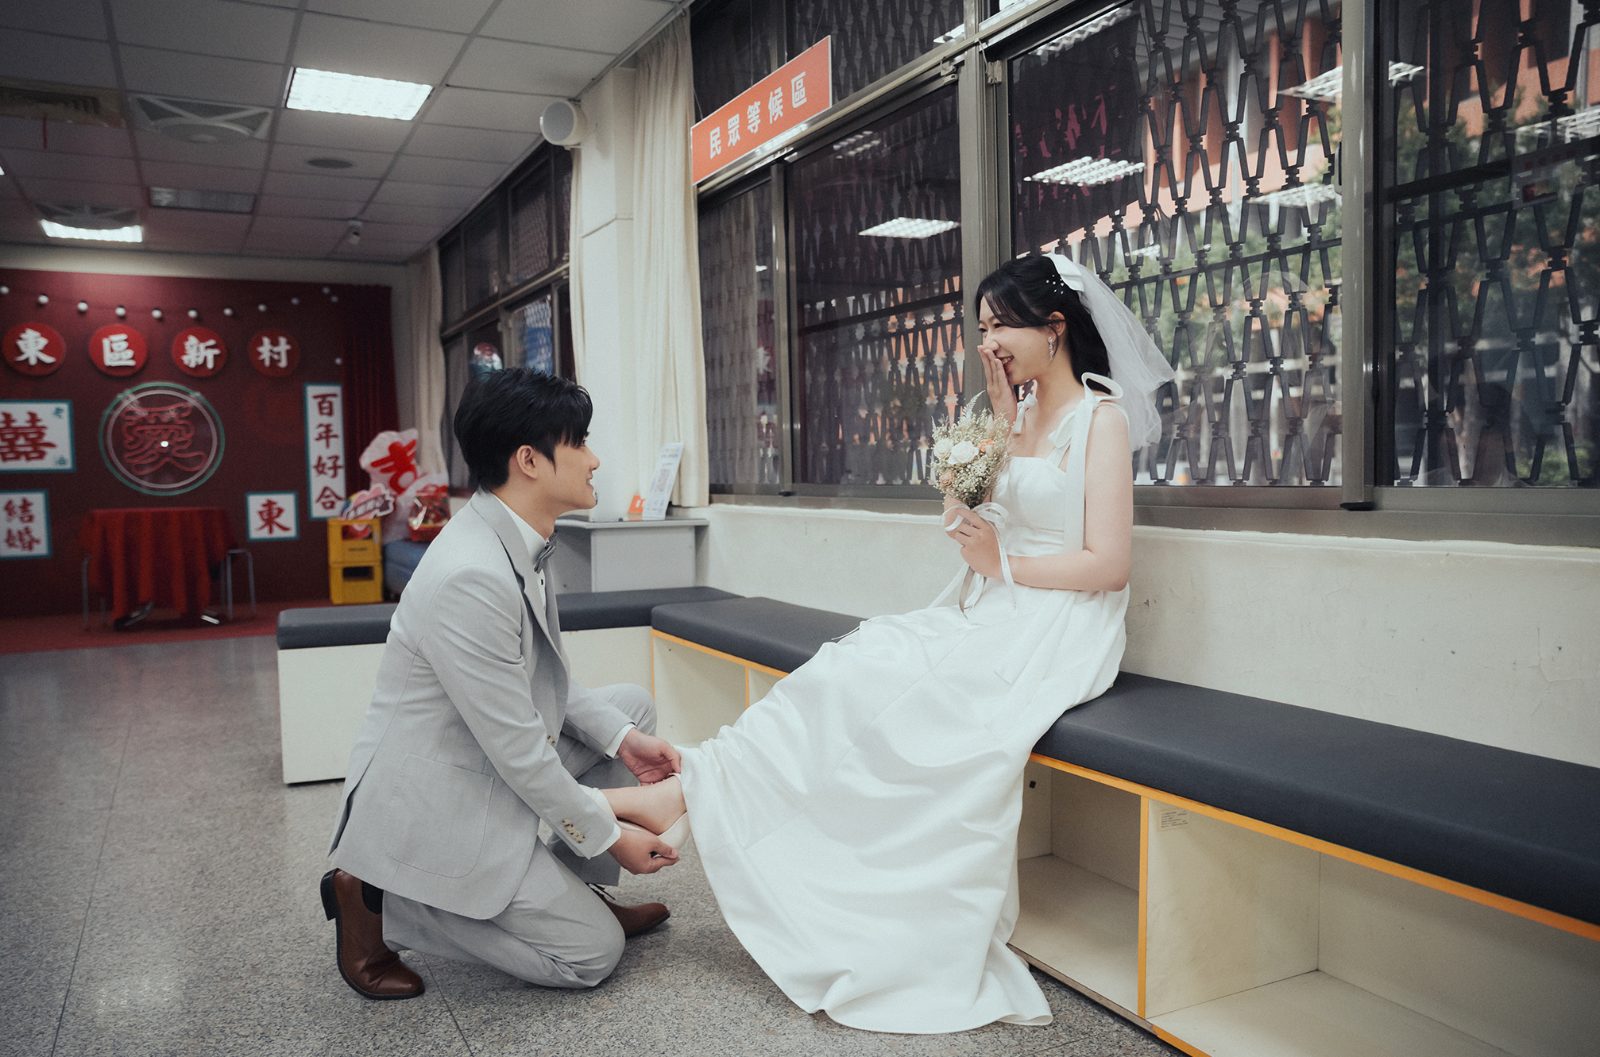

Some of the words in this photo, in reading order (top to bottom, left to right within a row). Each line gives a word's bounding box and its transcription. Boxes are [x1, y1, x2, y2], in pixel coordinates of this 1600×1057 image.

[709, 71, 808, 160] 民眾等候區
[15, 327, 292, 369] 東區新村
[312, 393, 344, 510] 百年好合
[4, 497, 41, 552] 結婚
[256, 499, 291, 535] 東
